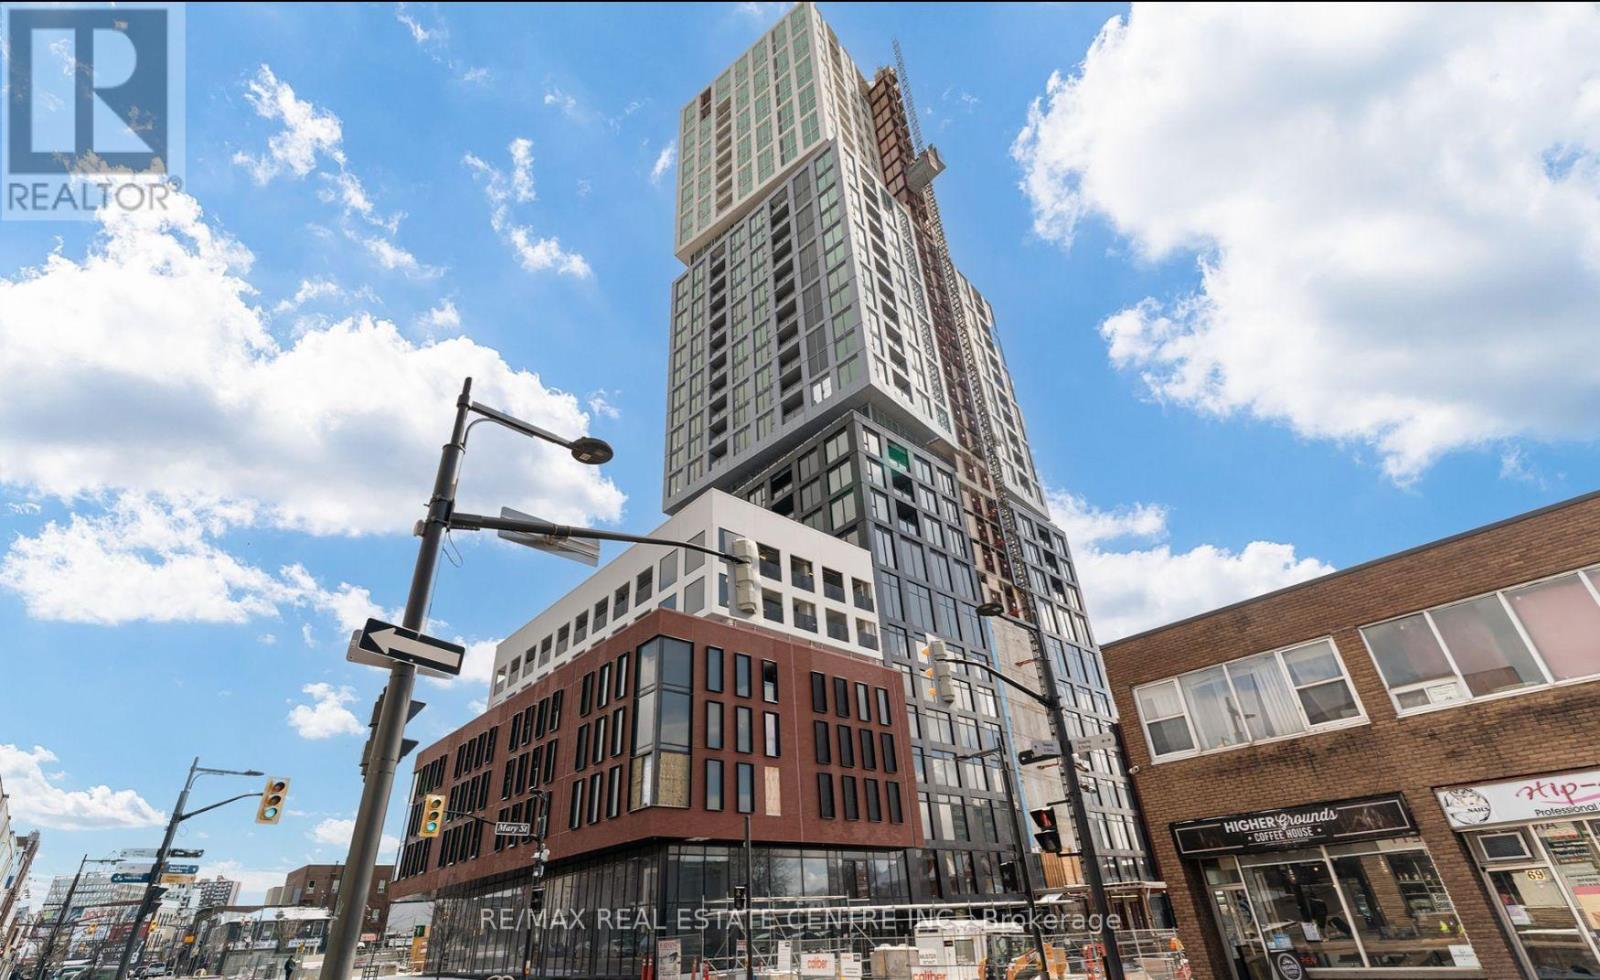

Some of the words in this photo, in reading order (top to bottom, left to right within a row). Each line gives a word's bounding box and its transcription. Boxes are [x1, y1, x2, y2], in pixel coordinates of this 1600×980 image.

[1534, 803, 1598, 817] Professional
[1223, 815, 1277, 834] HIGHER
[1275, 808, 1338, 831] Grounds
[498, 824, 518, 833] Mary
[519, 825, 527, 833] St
[1254, 829, 1285, 842] COFFEE
[1286, 826, 1314, 839] HOUSE
[1527, 870, 1544, 880] 69
[807, 956, 828, 969] caliber
[912, 970, 947, 980] caliber
